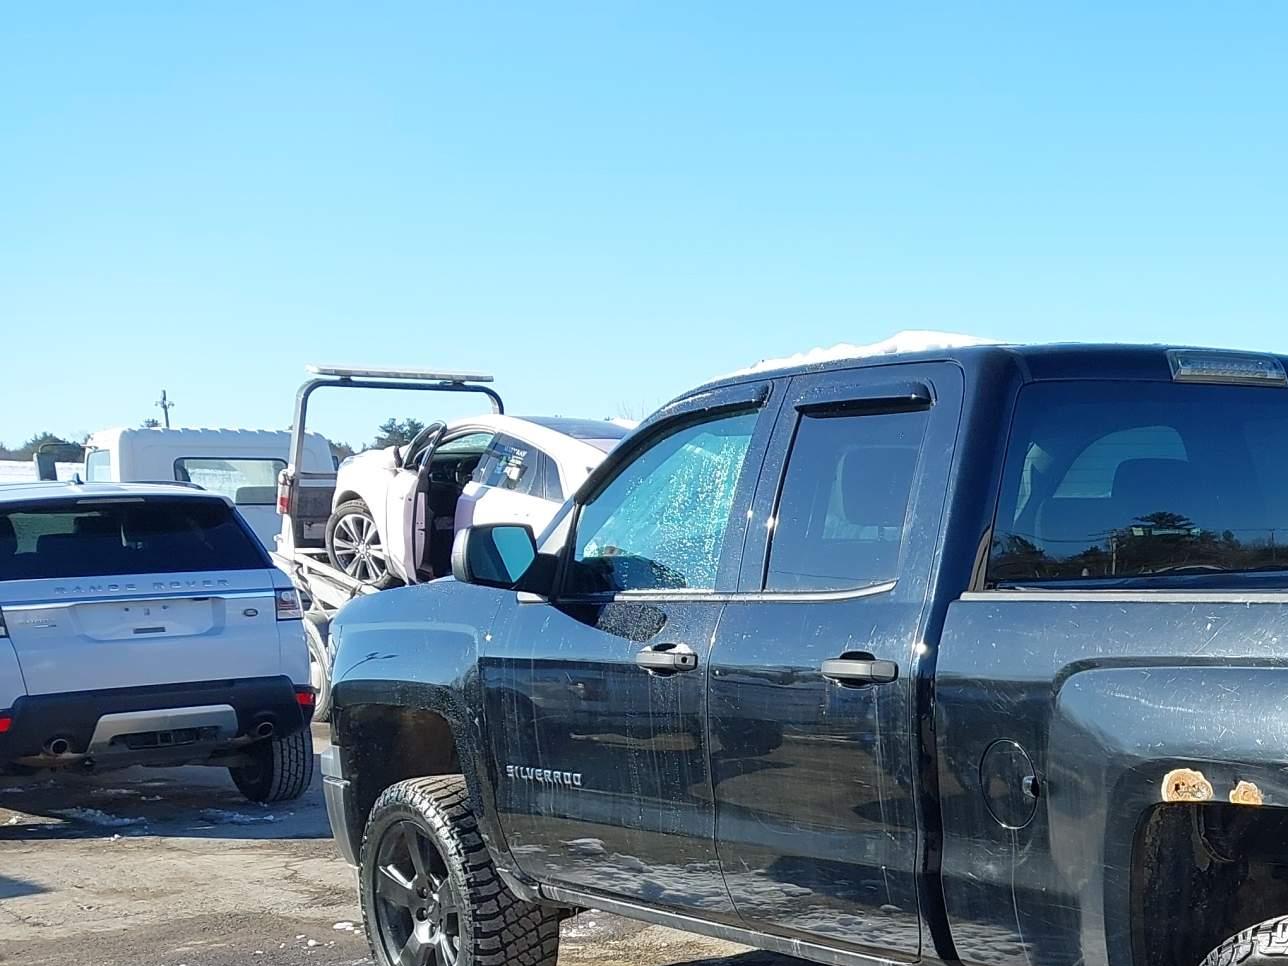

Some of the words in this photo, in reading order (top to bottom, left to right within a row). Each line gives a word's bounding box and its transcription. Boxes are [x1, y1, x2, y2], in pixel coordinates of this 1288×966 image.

[53, 583, 137, 594] RANGE
[152, 579, 230, 591] ROVER
[506, 765, 582, 786] SILVERADO
